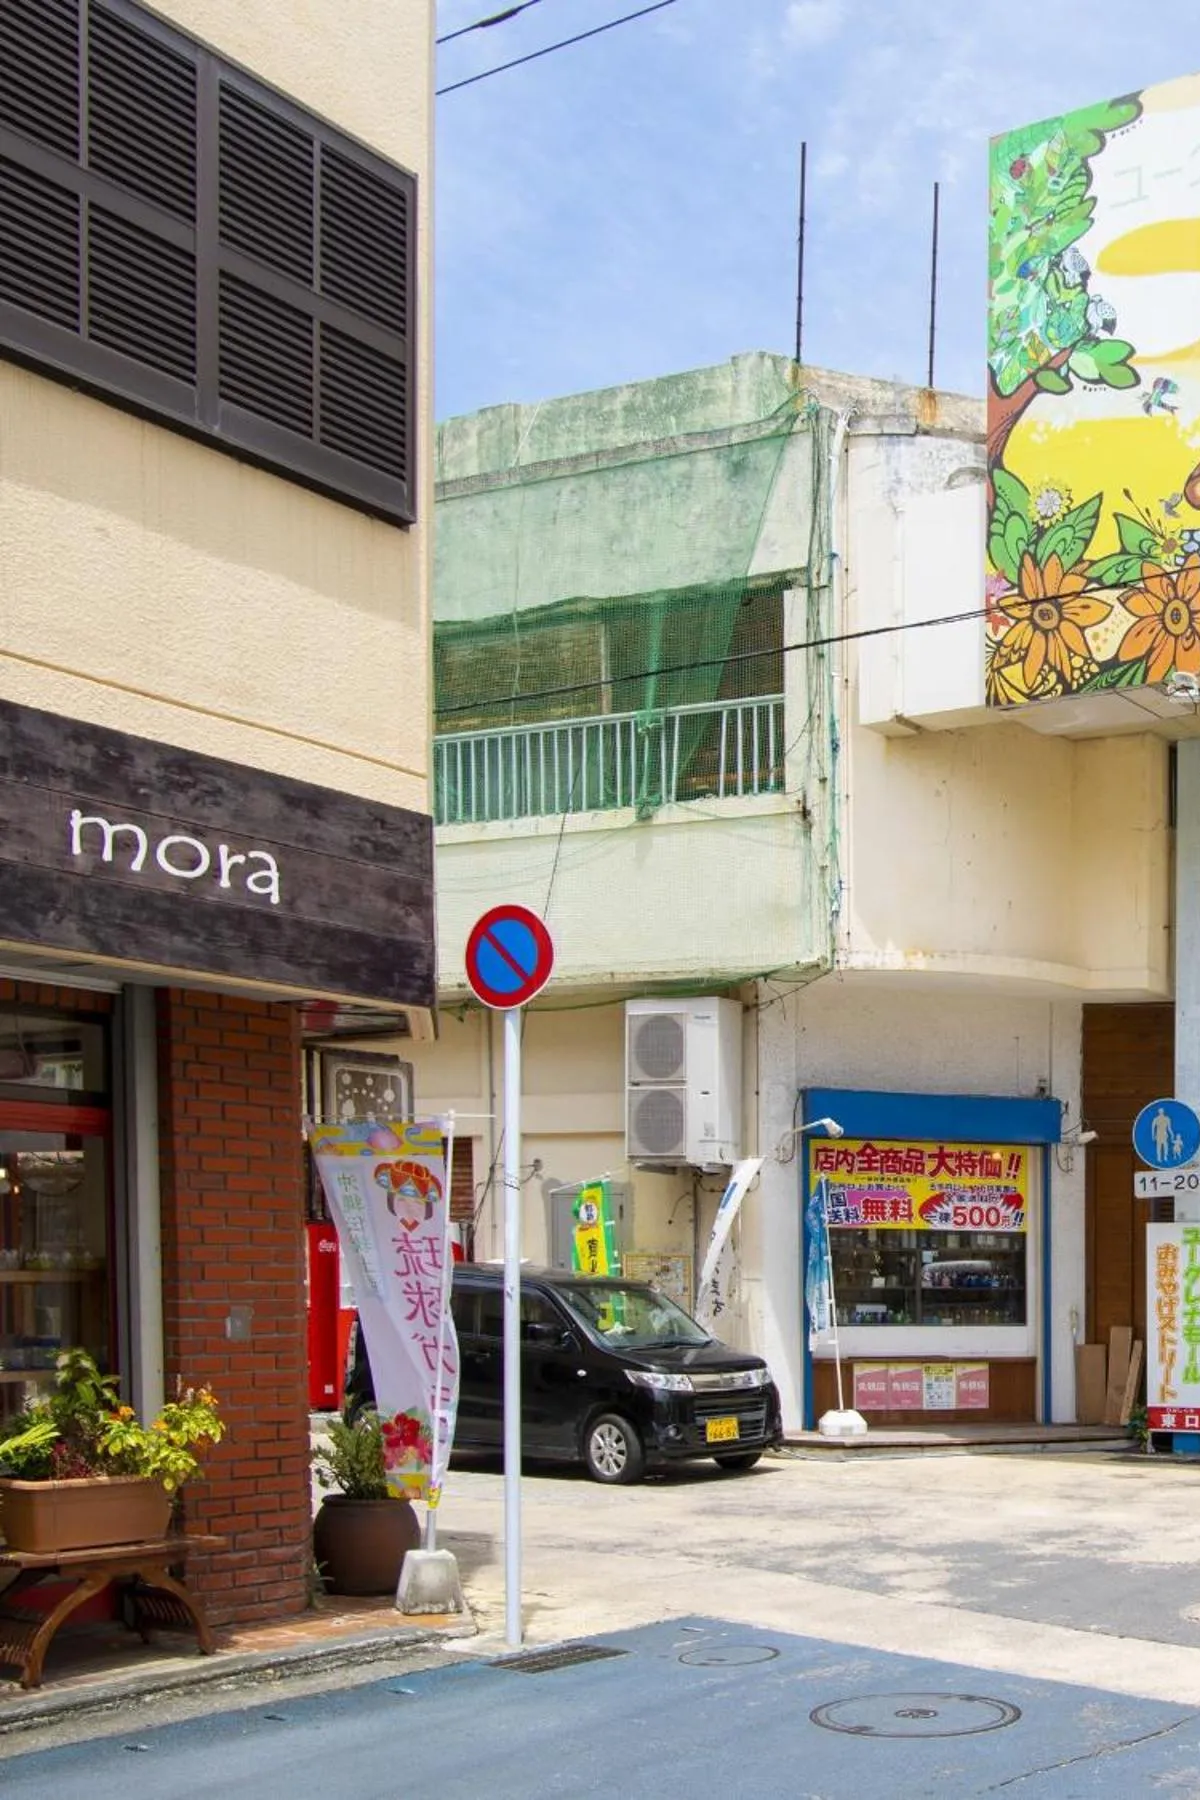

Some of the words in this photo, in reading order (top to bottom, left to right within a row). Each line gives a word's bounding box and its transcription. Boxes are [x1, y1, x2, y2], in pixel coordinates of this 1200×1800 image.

[70, 809, 281, 904] mora
[1139, 1174, 1200, 1192] 11-20
[1156, 1242, 1179, 1403] おみやげストリート
[1160, 1412, 1199, 1428] 東口
